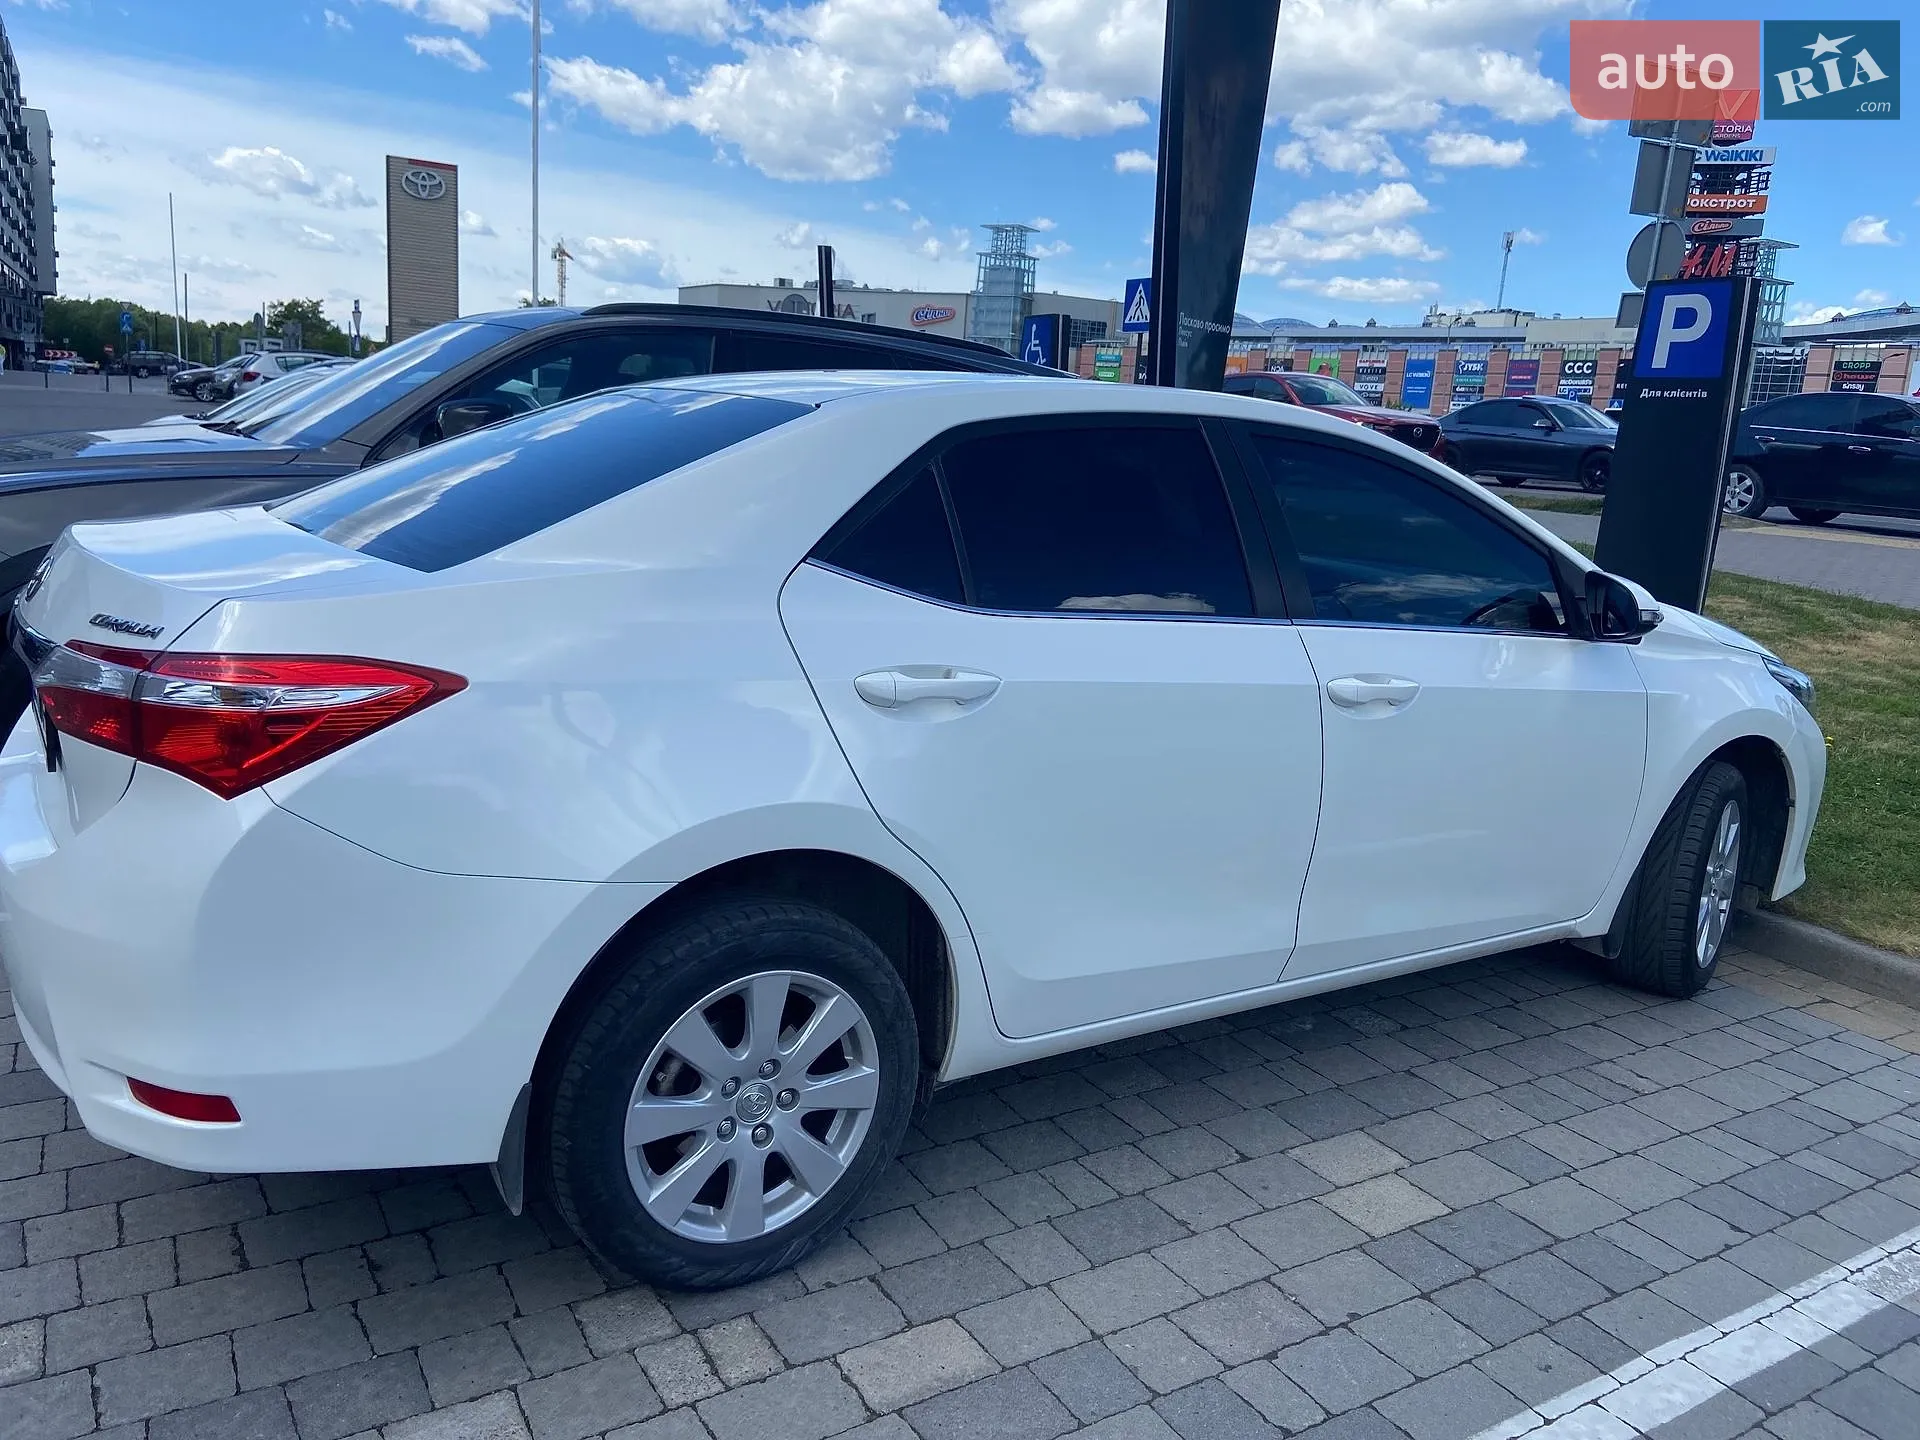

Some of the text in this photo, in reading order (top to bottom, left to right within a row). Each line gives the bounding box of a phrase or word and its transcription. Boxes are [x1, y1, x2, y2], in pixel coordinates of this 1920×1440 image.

[1179, 312, 1231, 334] Ласково просимо
[1651, 293, 1713, 369] P
[1565, 362, 1592, 374] CCC
[1640, 388, 1708, 399] Для клієнтів
[1842, 382, 1865, 391] sinsay
[88, 613, 165, 640] COROLLA
